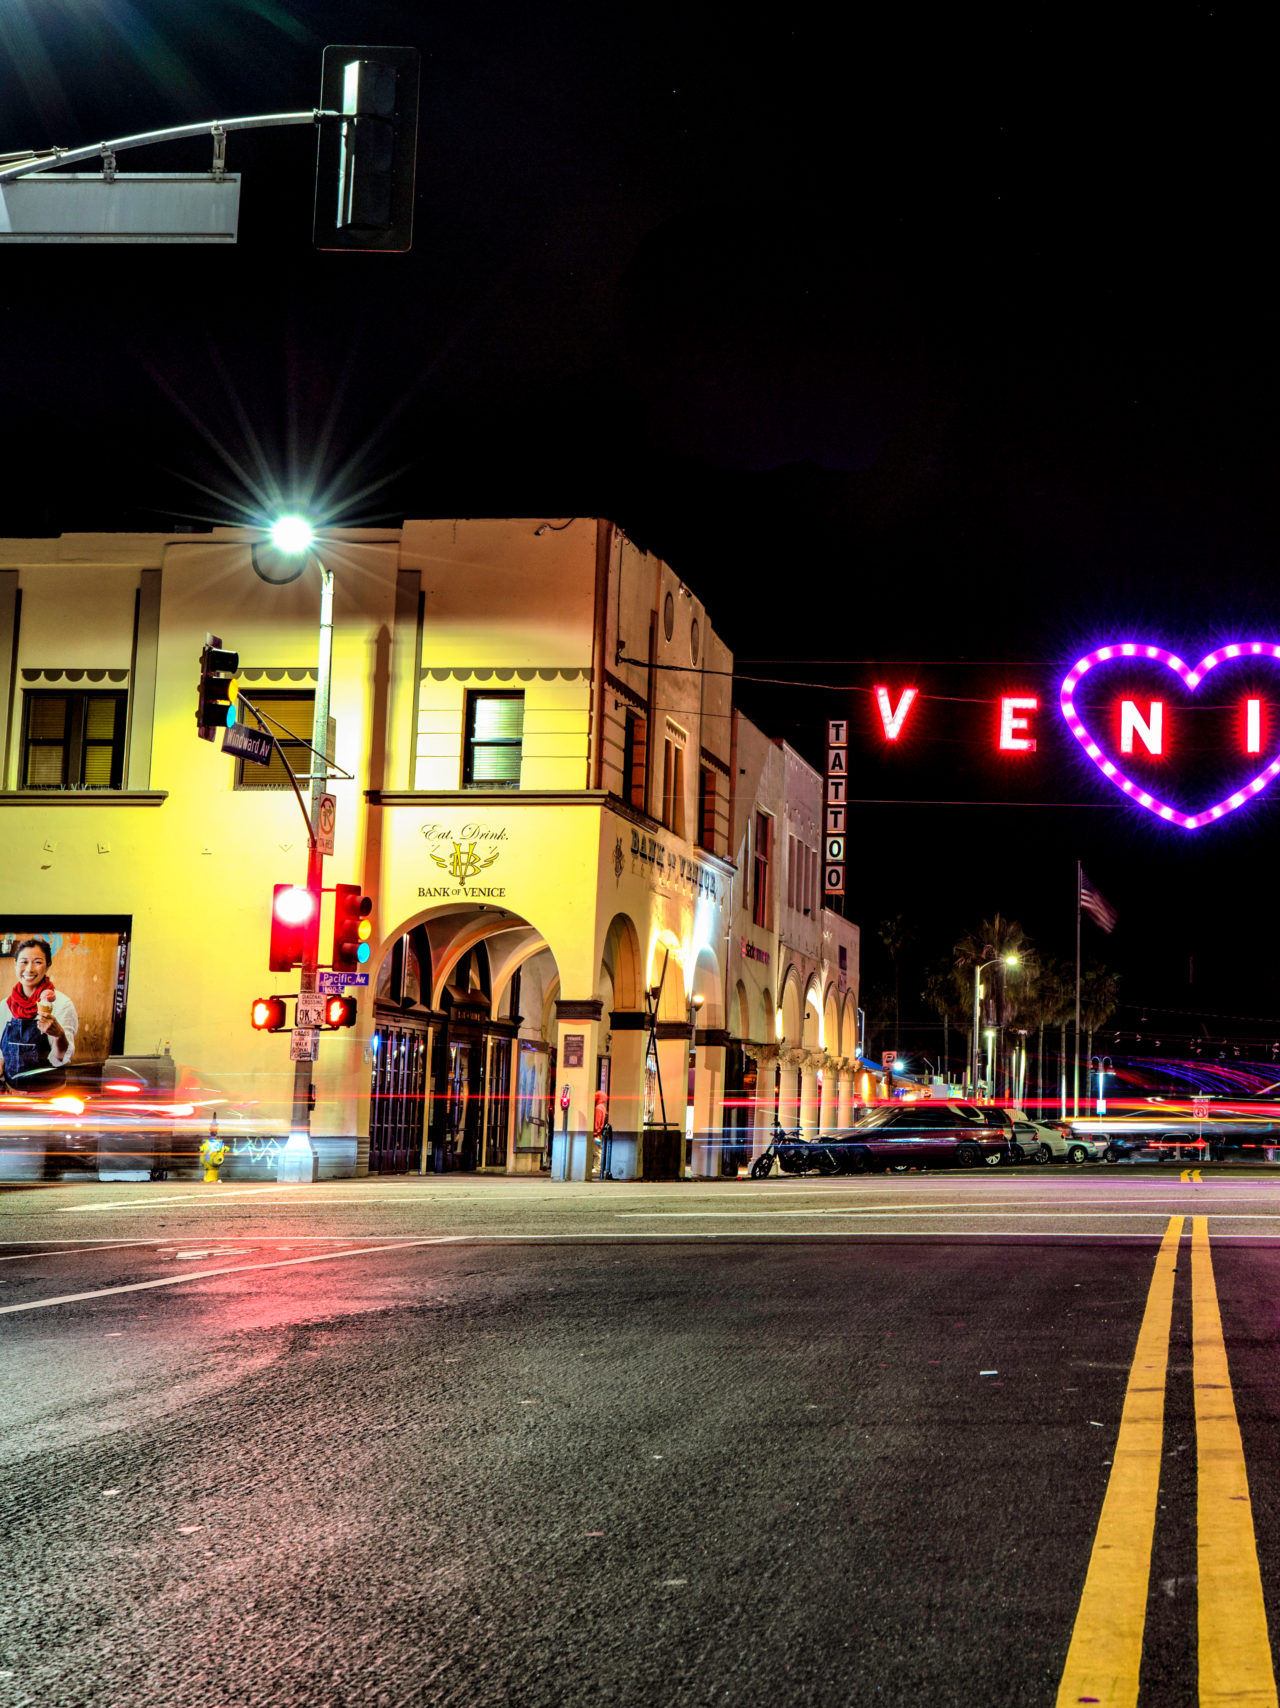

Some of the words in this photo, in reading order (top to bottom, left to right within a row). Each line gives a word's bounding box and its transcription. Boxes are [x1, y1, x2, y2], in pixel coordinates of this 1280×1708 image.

[227, 728, 260, 754] Windward
[260, 740, 270, 757] Av
[827, 723, 844, 887] TATTOO
[421, 823, 453, 841] Eat.
[460, 823, 509, 841] Drink.
[631, 828, 665, 868] BANK
[679, 855, 716, 894] VENICE
[418, 887, 450, 897] BANK
[463, 887, 506, 897] VENICE
[323, 973, 352, 984] Pacific
